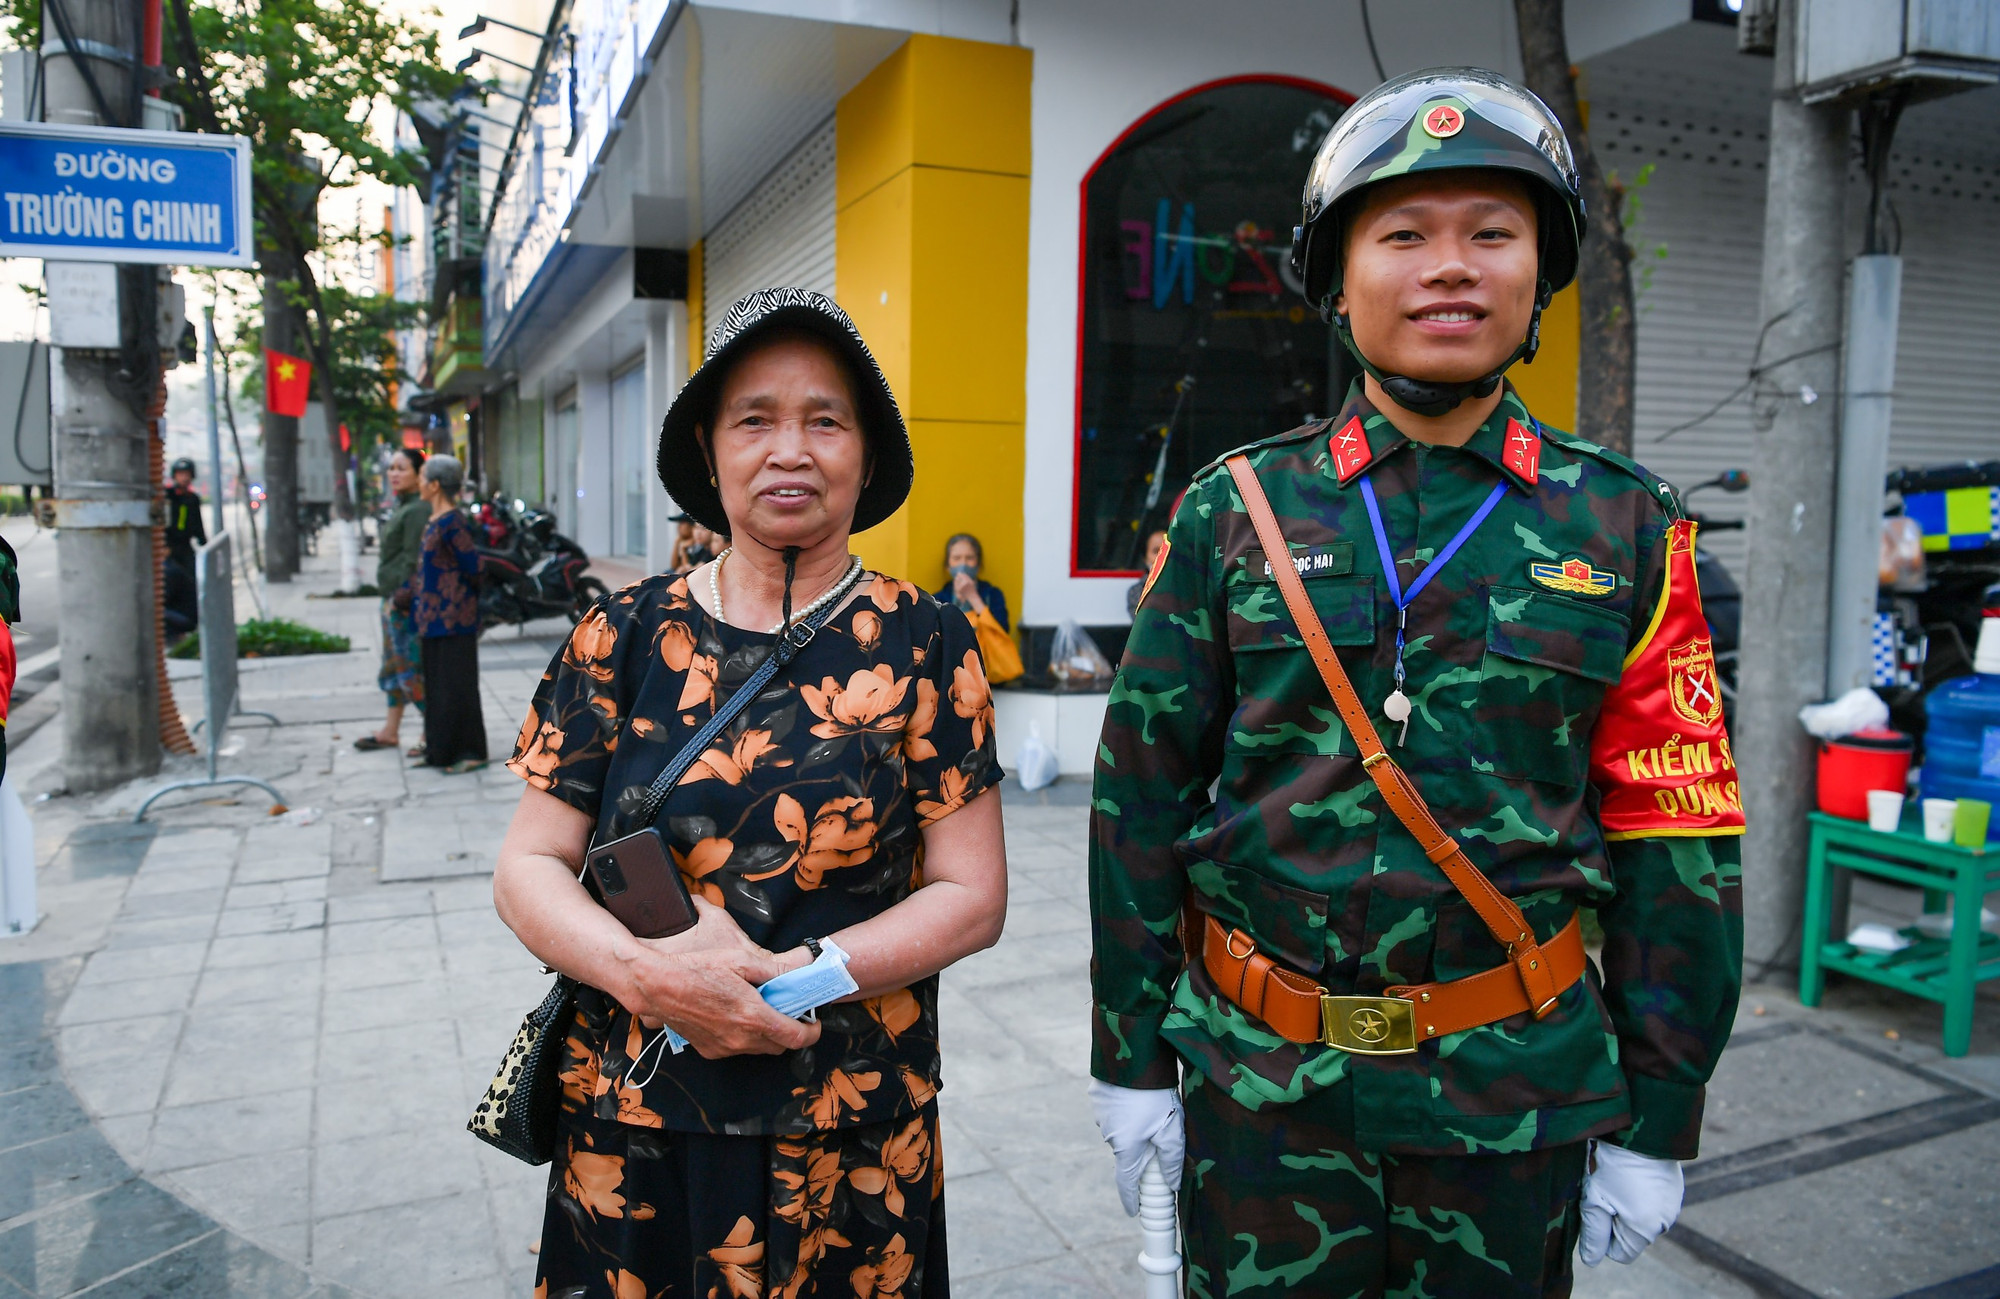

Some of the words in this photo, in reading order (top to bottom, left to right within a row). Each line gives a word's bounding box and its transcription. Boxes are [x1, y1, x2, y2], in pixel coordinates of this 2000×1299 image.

[54, 149, 177, 184] ĐƯỜNG
[4, 184, 125, 240] TRƯỜNG
[132, 199, 222, 245] CHINH
[1627, 733, 1714, 781] KIỂM
[1719, 736, 1736, 771] S
[1724, 780, 1744, 813] S
